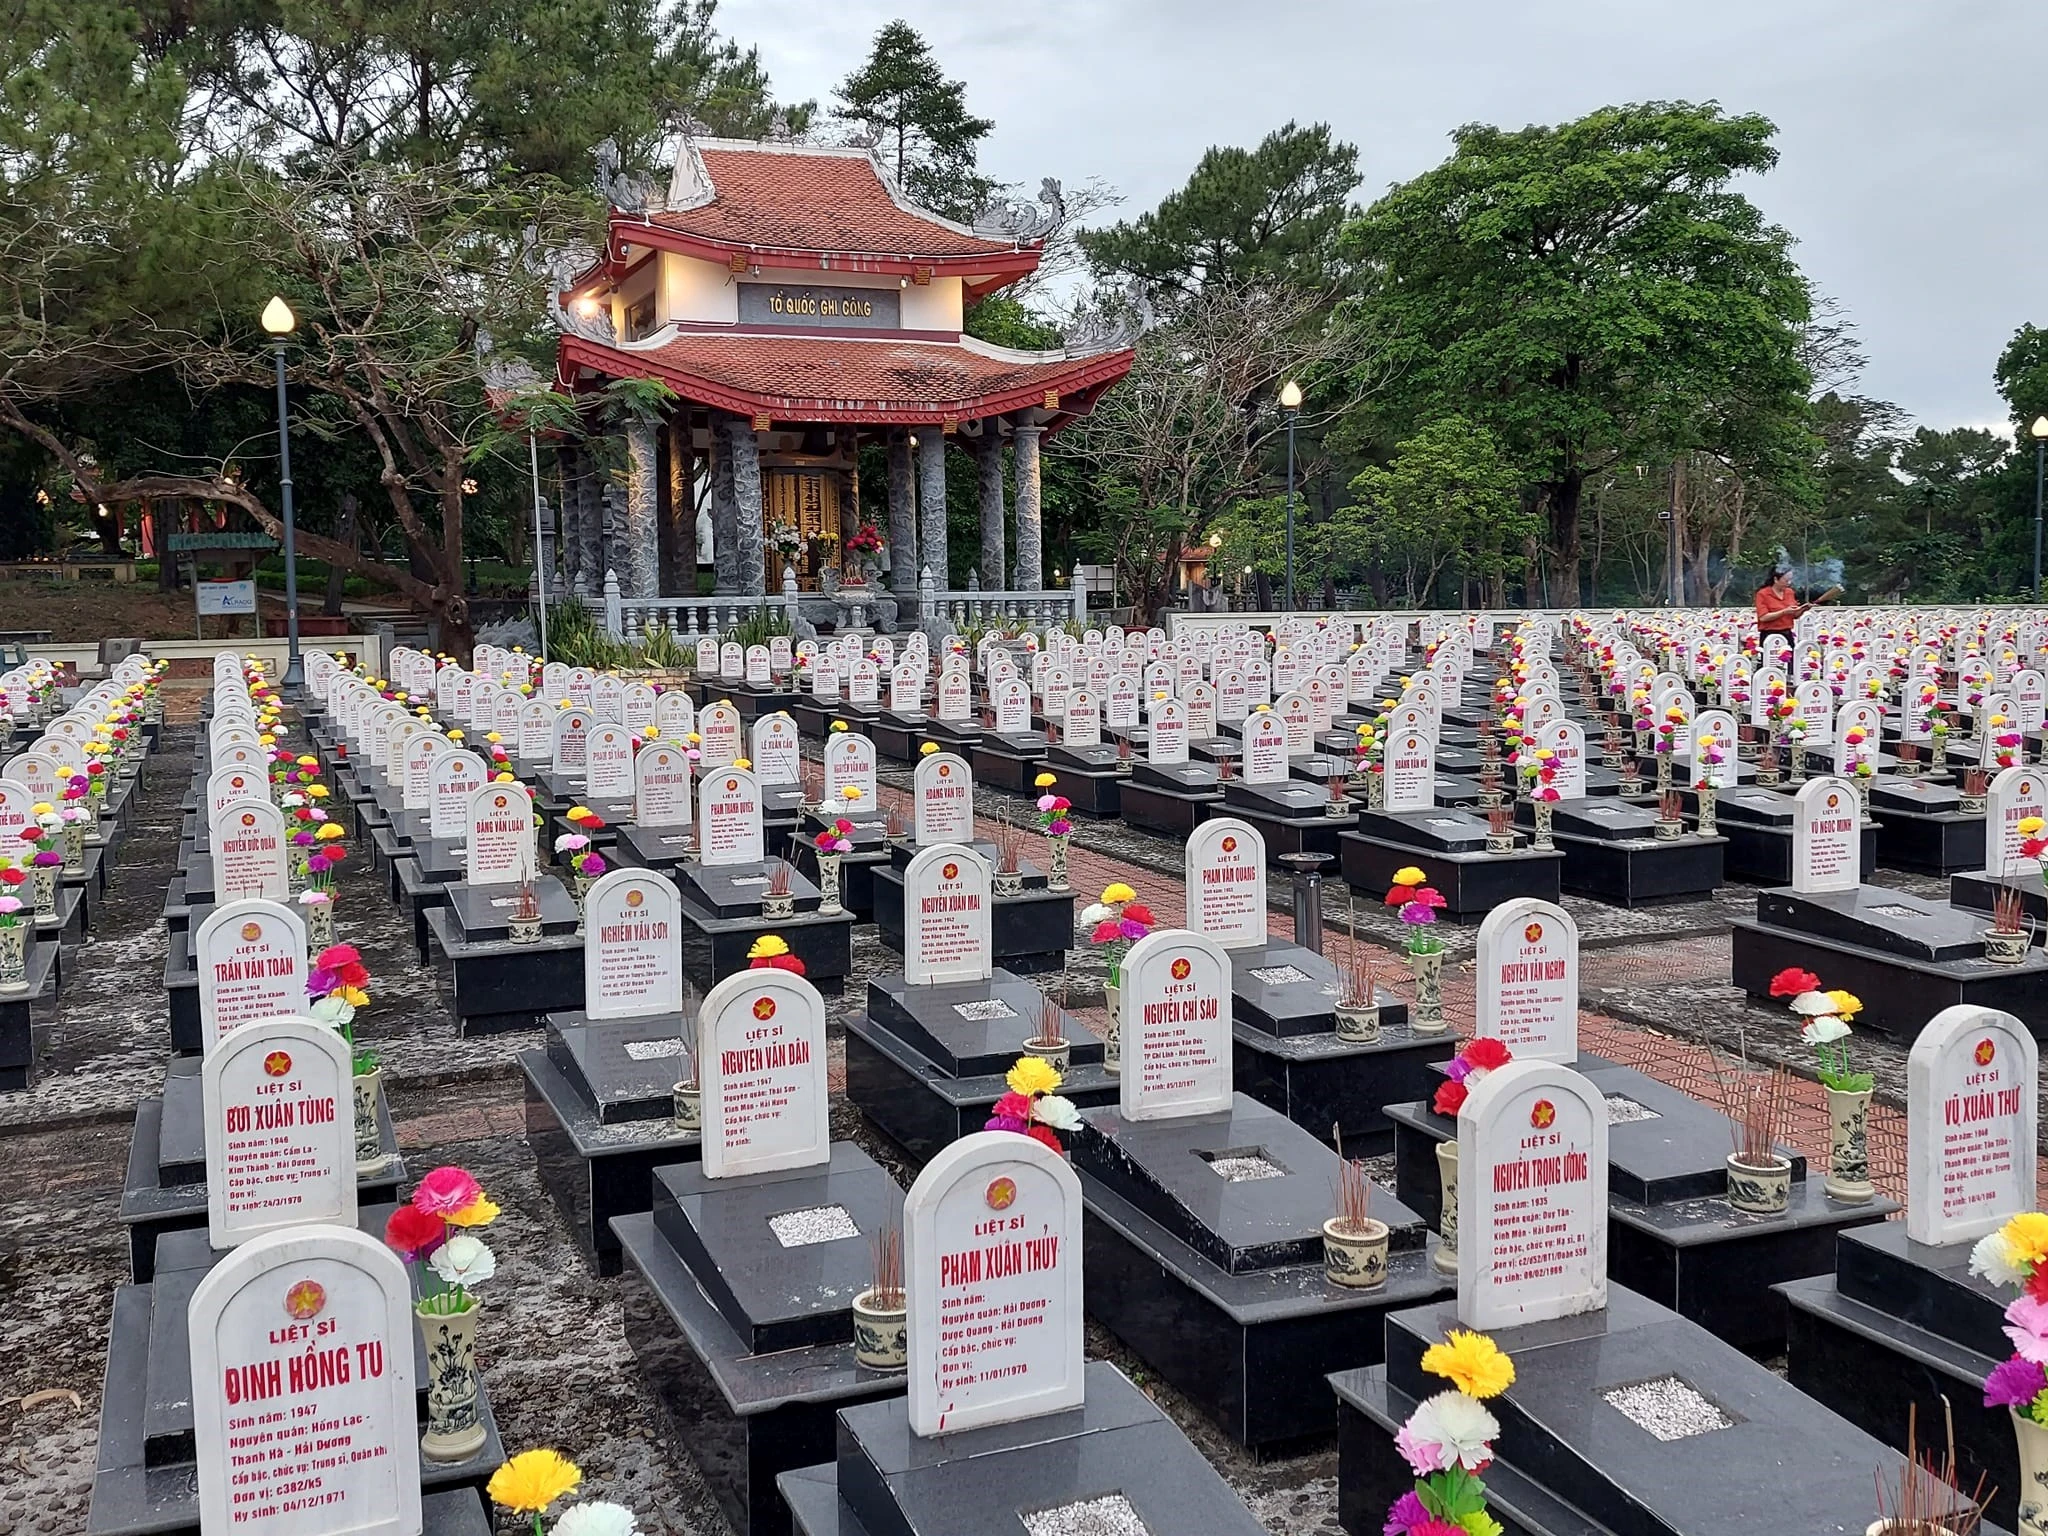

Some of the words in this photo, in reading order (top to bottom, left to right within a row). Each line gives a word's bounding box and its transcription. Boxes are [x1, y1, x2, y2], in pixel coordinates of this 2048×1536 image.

[786, 292, 815, 314] QUỐC
[821, 301, 837, 315] GHI
[1165, 984, 1184, 994] LIỆT
[1183, 996, 1197, 1021] CHÍ
[746, 1028, 768, 1040] LIỆT
[765, 1041, 786, 1069] VĂN
[789, 1037, 809, 1065] DÂN
[1966, 1072, 1986, 1086] LIỆT
[257, 1083, 284, 1096] LIỆT
[1964, 1088, 1994, 1123] XUÂN
[255, 1098, 293, 1130] XUÂN
[228, 1142, 246, 1150] Sinh
[1521, 1135, 1545, 1149] LIỆT
[229, 1167, 243, 1175] Kim
[300, 1169, 321, 1178] Trung
[1494, 1203, 1509, 1212] Sinh
[975, 1219, 1005, 1236] LIỆT
[1009, 1215, 1024, 1229] SĨ
[941, 1250, 981, 1291] PHẠM
[986, 1239, 1021, 1280] XUÂN
[942, 1299, 961, 1309] Sinh
[942, 1312, 974, 1325] Nguyên
[269, 1324, 309, 1344] LIỆT
[317, 1318, 336, 1336] SĨ
[967, 1325, 993, 1337] Quang
[289, 1340, 350, 1393] HỒNG
[943, 1380, 953, 1389] Hy
[956, 1375, 976, 1386] sinh:
[229, 1417, 254, 1430] Sinh
[291, 1404, 317, 1418] 1947
[230, 1432, 273, 1448] Nguyên
[232, 1453, 265, 1466] Thanh
[317, 1436, 351, 1451] Dương
[312, 1457, 335, 1470] Trung
[234, 1512, 247, 1522] Hy
[252, 1505, 279, 1519] sinh:
[283, 1491, 345, 1513] 04/12/1971
